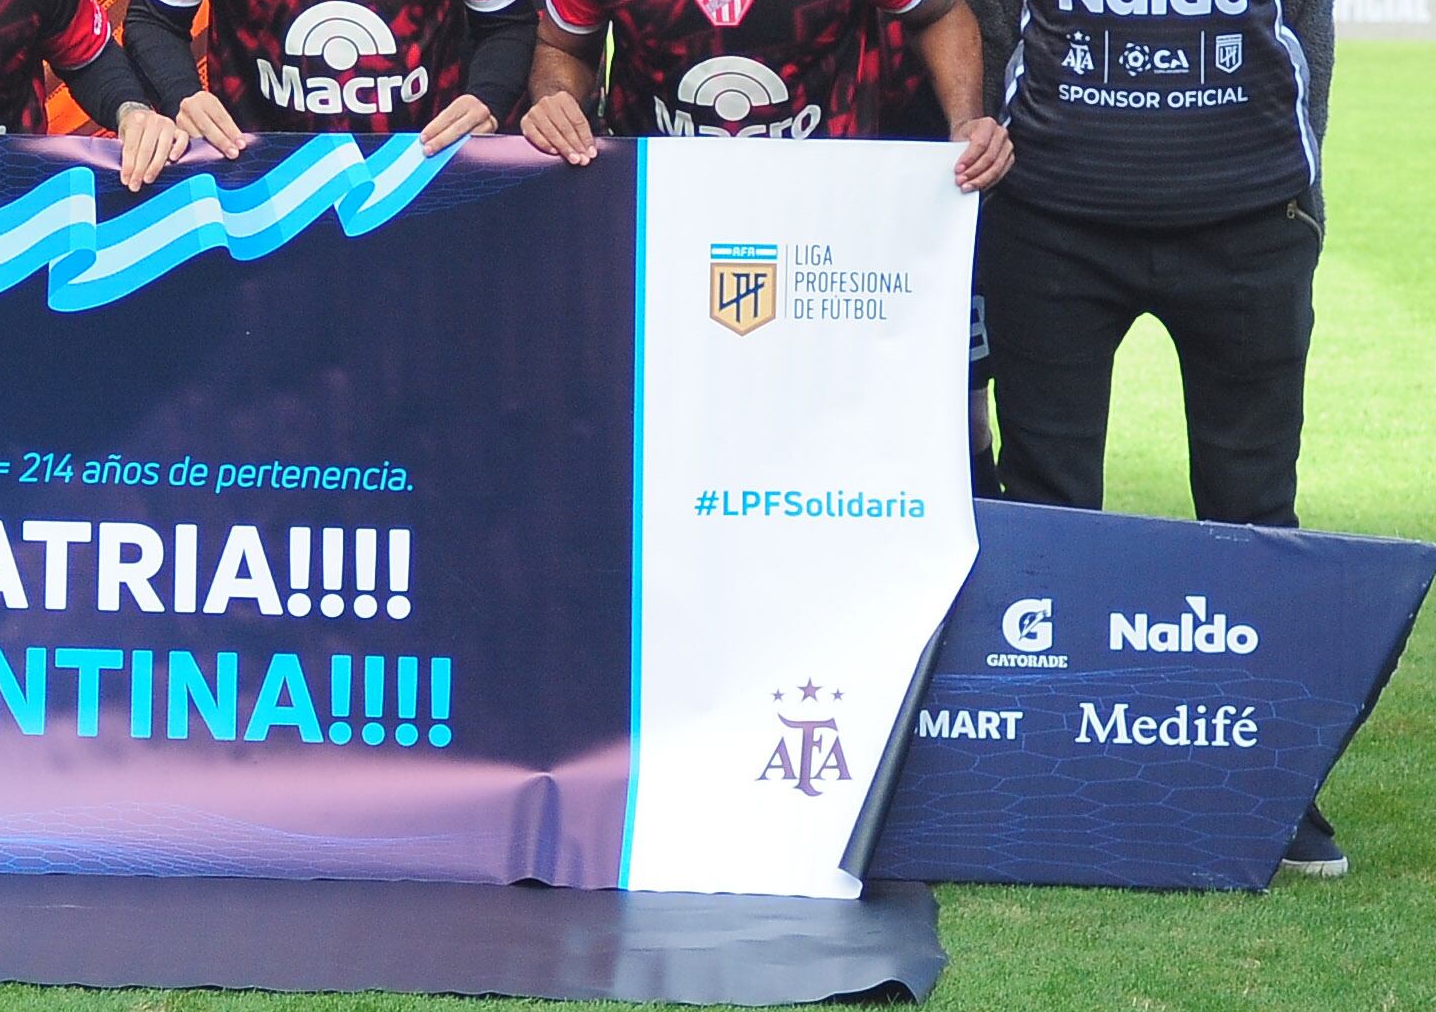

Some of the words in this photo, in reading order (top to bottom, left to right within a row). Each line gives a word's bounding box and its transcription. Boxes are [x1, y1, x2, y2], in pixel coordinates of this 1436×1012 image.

[256, 57, 430, 115] Macro
[1058, 83, 1161, 110] SPONSOR
[1166, 86, 1250, 110] OFICIAL
[794, 243, 834, 267] LIGA
[793, 271, 913, 295] PROFESIONAL
[793, 297, 815, 320] DE
[820, 294, 889, 321] FÚTBOL
[18, 452, 74, 484] 214
[81, 453, 161, 486] años
[168, 455, 209, 487] de
[215, 460, 414, 494] pertenencia.
[693, 489, 926, 519] #LPFSolidaria
[1108, 612, 1260, 655] Naldo
[985, 653, 1069, 669] GATORADE
[914, 709, 1025, 740] MART
[1073, 702, 1259, 749] Medifé
